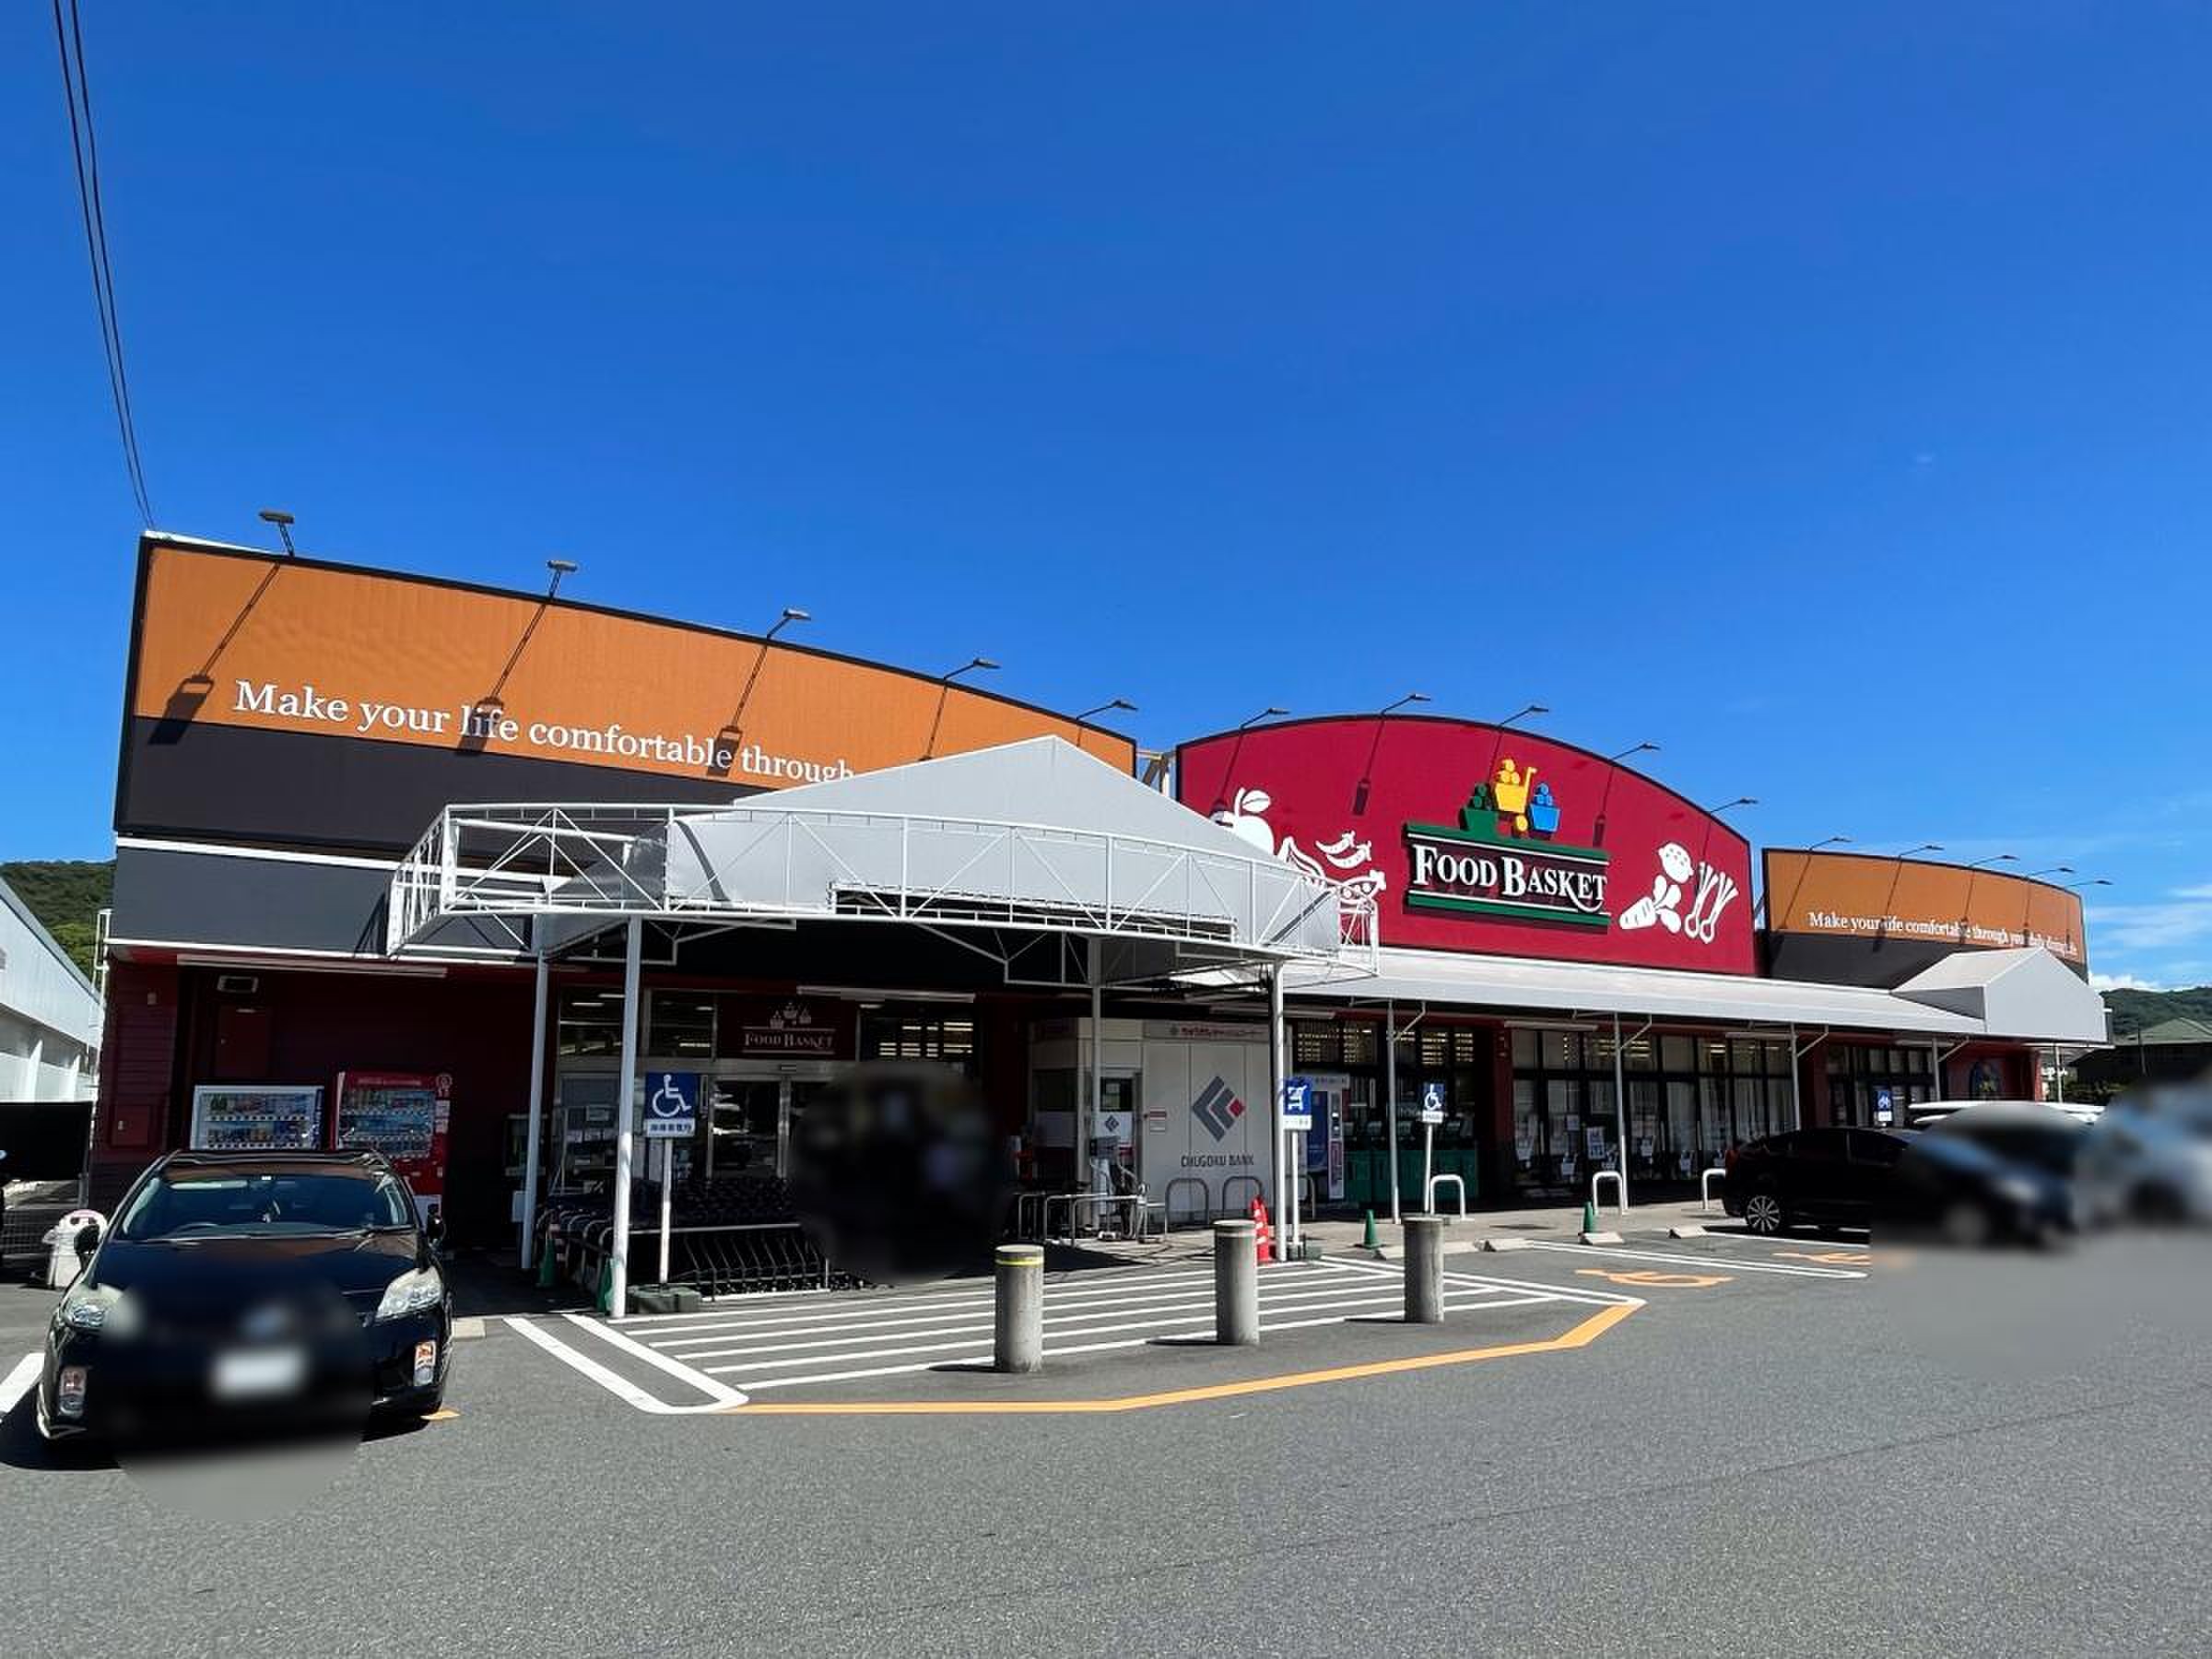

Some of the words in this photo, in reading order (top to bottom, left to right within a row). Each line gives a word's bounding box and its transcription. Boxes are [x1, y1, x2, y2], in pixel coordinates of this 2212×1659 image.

[232, 678, 348, 721] Make
[356, 700, 450, 734] your
[460, 705, 519, 742] life
[529, 722, 734, 769] comfortable
[740, 745, 856, 782] through
[1412, 843, 1498, 887] FOOD
[1500, 856, 1607, 912] BASKET
[1808, 912, 1849, 929] Make
[1850, 916, 1880, 933] your
[1906, 919, 1972, 939] comfortabe
[744, 1033, 782, 1047] FOOD
[1181, 1154, 1225, 1168] CHUGOKU
[1228, 1154, 1254, 1166] BANK
